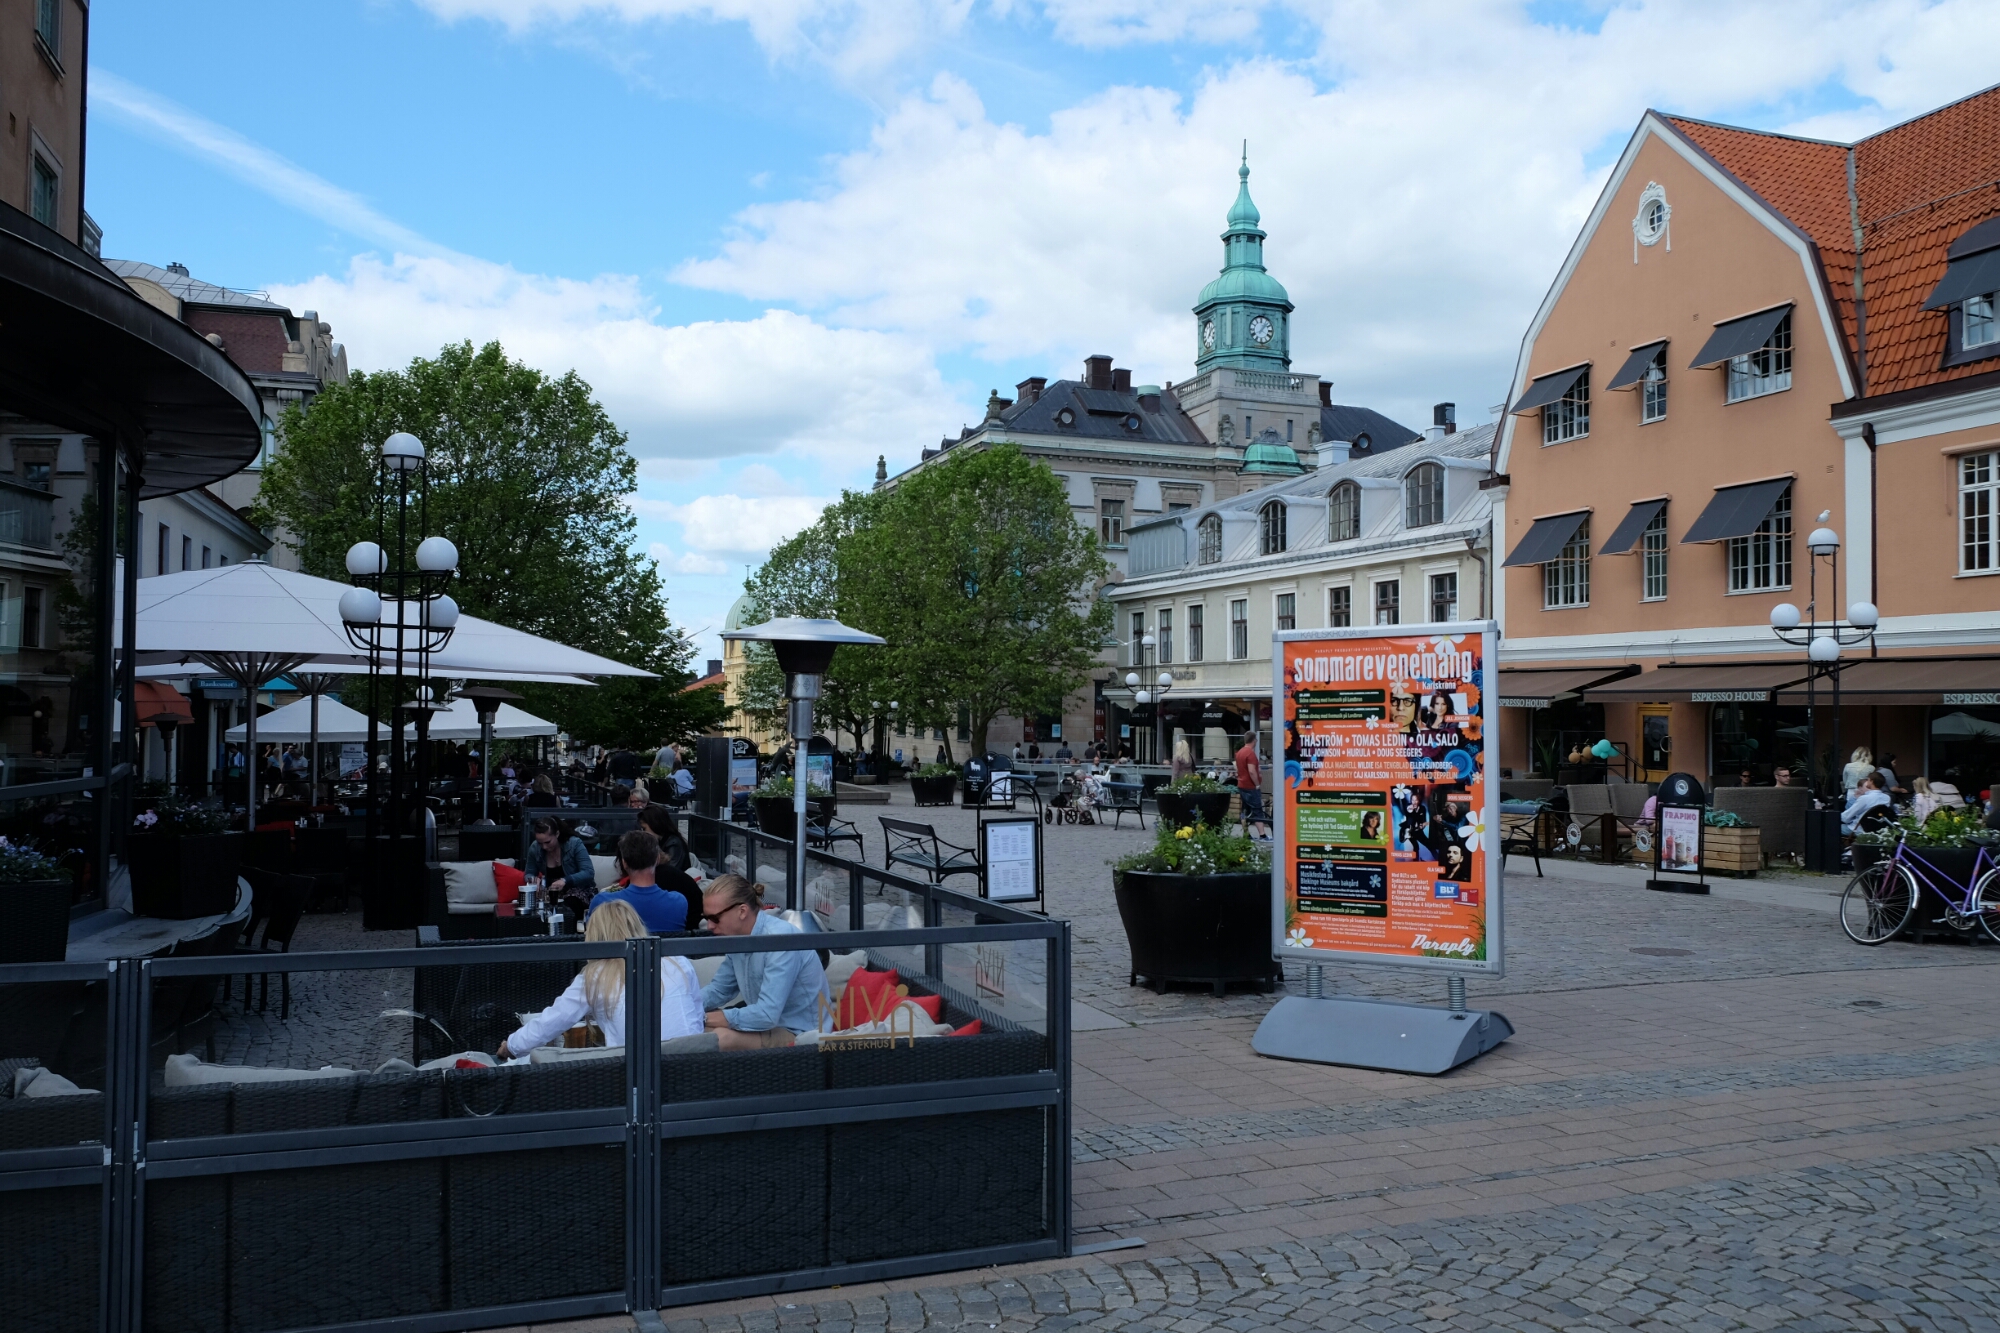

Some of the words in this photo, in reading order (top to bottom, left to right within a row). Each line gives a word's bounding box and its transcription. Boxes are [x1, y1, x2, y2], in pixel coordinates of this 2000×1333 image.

[1294, 651, 1472, 683] sommarevenemang
[1422, 680, 1456, 689] Karlskrona
[1690, 692, 1732, 702] ESPRESSO
[1734, 692, 1767, 701] HOUSE
[1499, 699, 1524, 707] SPRESSO
[1526, 699, 1548, 708] HOUSE
[1300, 732, 1342, 746] THÅSTRÖM
[1352, 734, 1380, 746] TOMAS
[1382, 734, 1407, 746] LEDIN
[1416, 734, 1433, 746] OLA
[1436, 733, 1458, 746] SALO
[1300, 748, 1311, 757] JILL
[1313, 748, 1340, 757] JOHNSON
[1347, 748, 1370, 757] HURULA
[1377, 748, 1394, 757] DOUG
[1396, 748, 1422, 757] SEEGERS
[1664, 810, 1697, 821] FRAPINO
[1410, 934, 1476, 956] Paraply
[818, 1042, 837, 1052] BAR
[839, 1042, 846, 1051] &
[848, 1040, 889, 1050] STEKHUS
